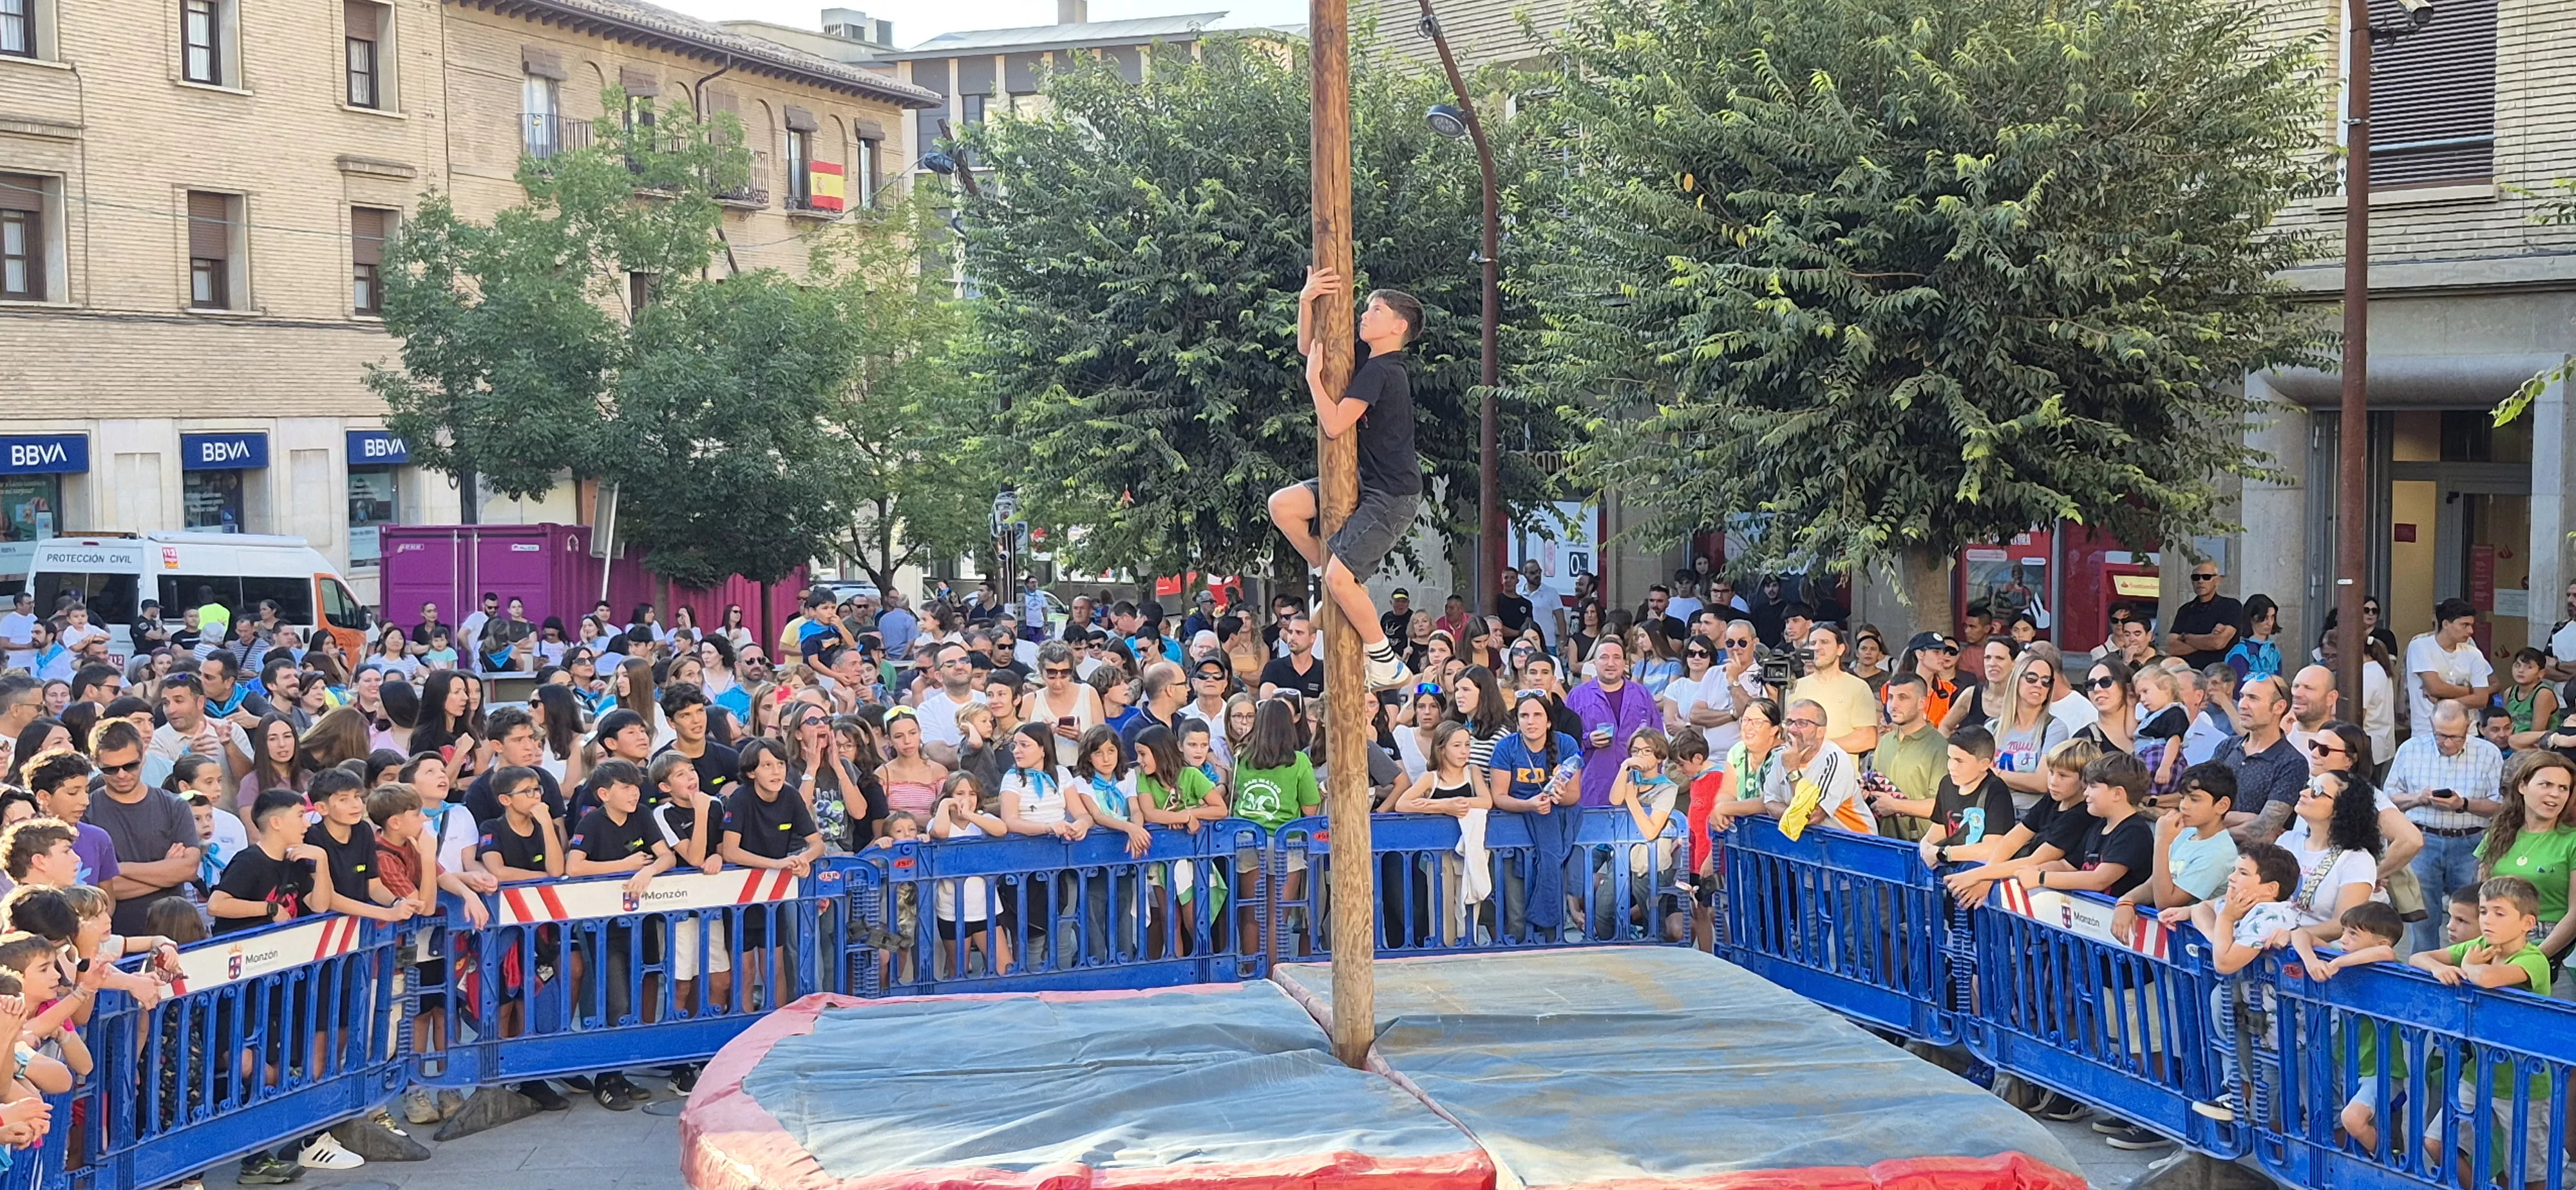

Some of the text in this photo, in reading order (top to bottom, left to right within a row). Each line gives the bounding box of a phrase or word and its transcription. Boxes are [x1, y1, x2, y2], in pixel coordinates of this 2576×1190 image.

[12, 442, 68, 466] BBVA
[202, 439, 251, 462] BBVA
[364, 438, 406, 457] BBVA
[46, 553, 132, 563] PROTECCIÓN CIVIL
[821, 872, 838, 880] JSP
[644, 889, 688, 900] Monzón
[2074, 910, 2100, 927] Monzón
[245, 949, 278, 964] Monzón
